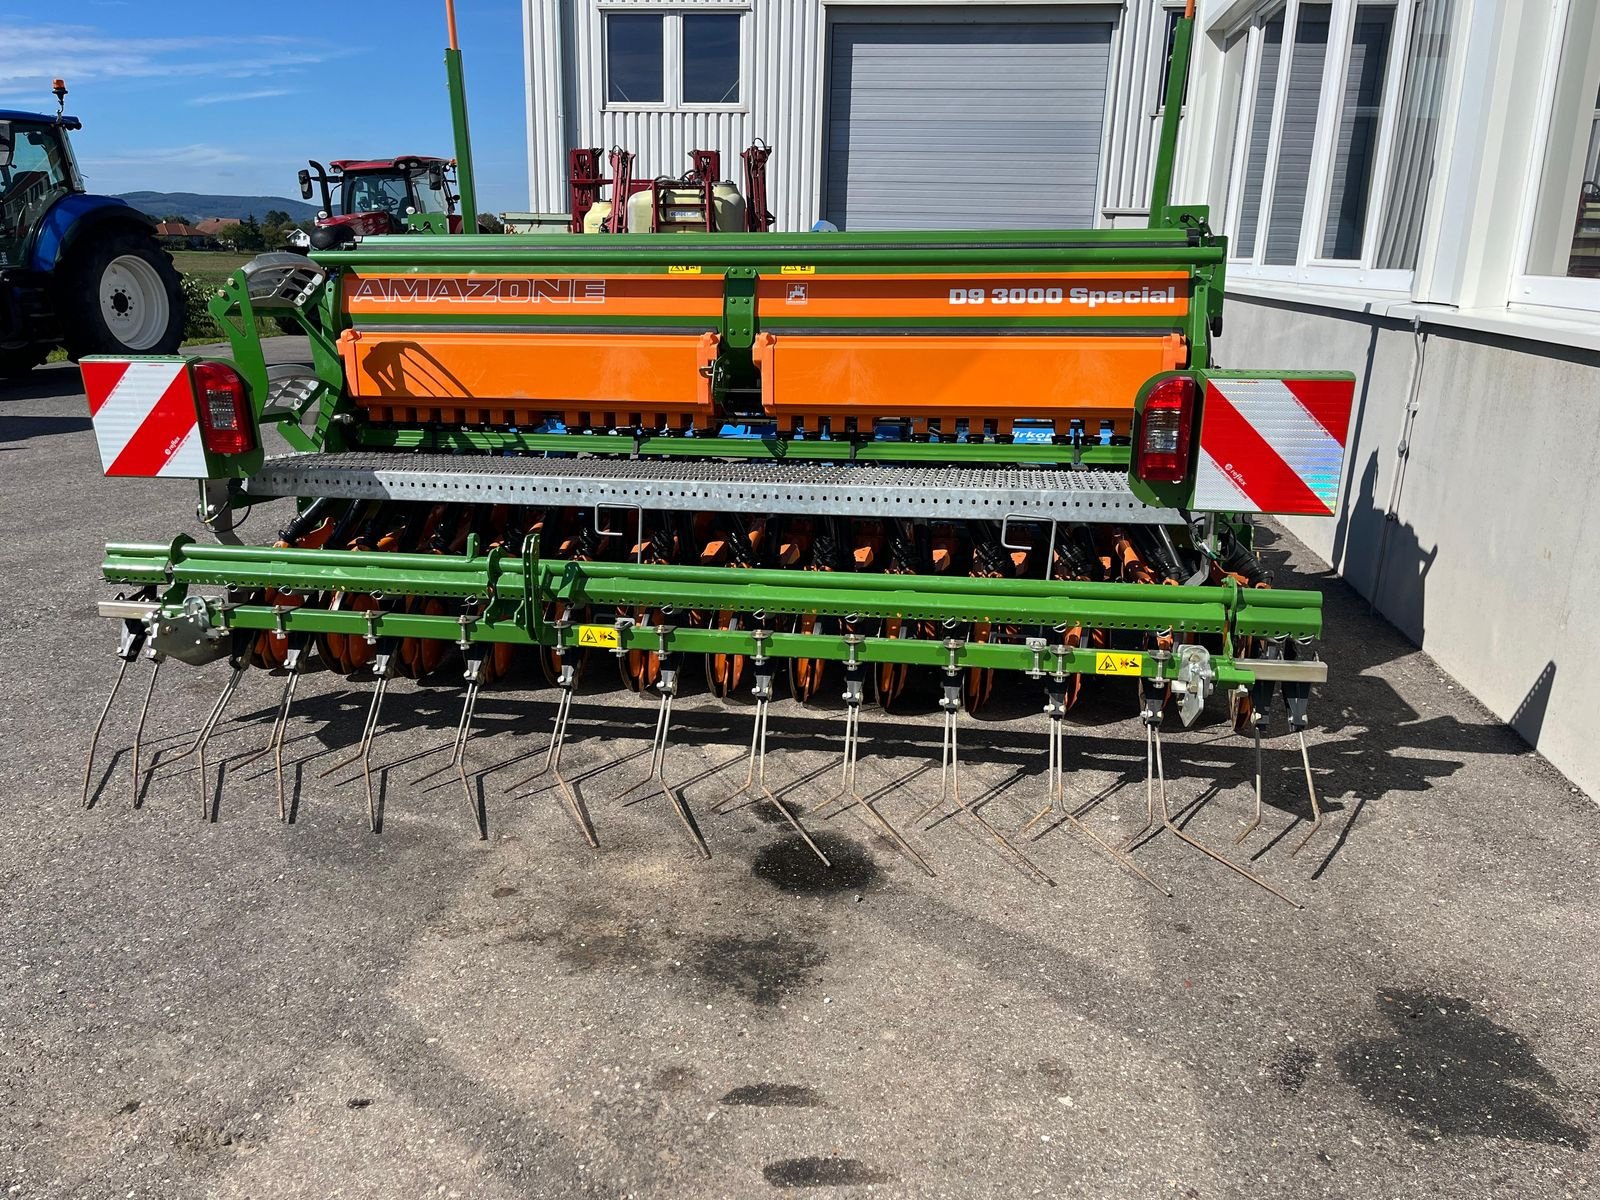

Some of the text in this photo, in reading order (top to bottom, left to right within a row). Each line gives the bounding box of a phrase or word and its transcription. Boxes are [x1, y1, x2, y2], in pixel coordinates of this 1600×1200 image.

[353, 278, 606, 304] AMAZONE
[949, 286, 1175, 308] D9 3000 Special
